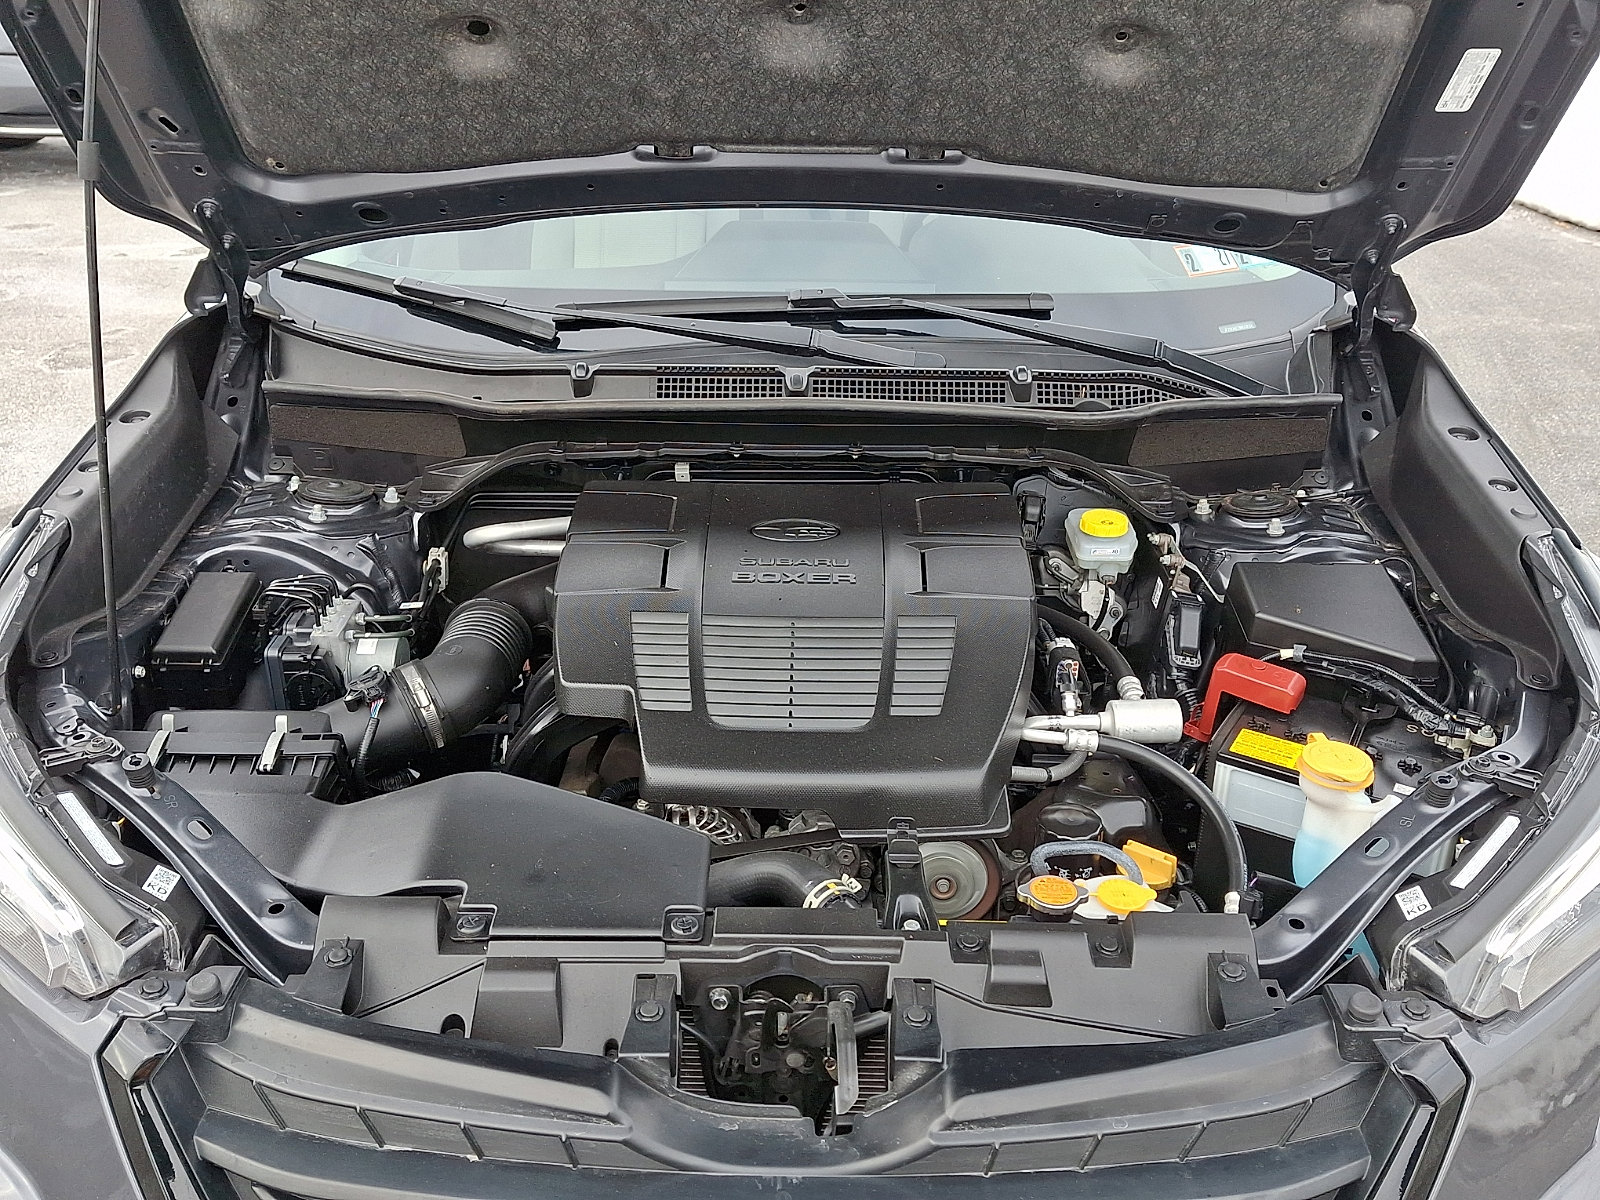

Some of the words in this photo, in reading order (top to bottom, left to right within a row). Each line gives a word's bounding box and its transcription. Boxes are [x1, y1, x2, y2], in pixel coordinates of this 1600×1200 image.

[1184, 253, 1200, 272] 2
[739, 557, 850, 567] SUBARU
[731, 571, 857, 584] BOXER
[146, 882, 168, 895] KD
[1406, 903, 1428, 916] KD
